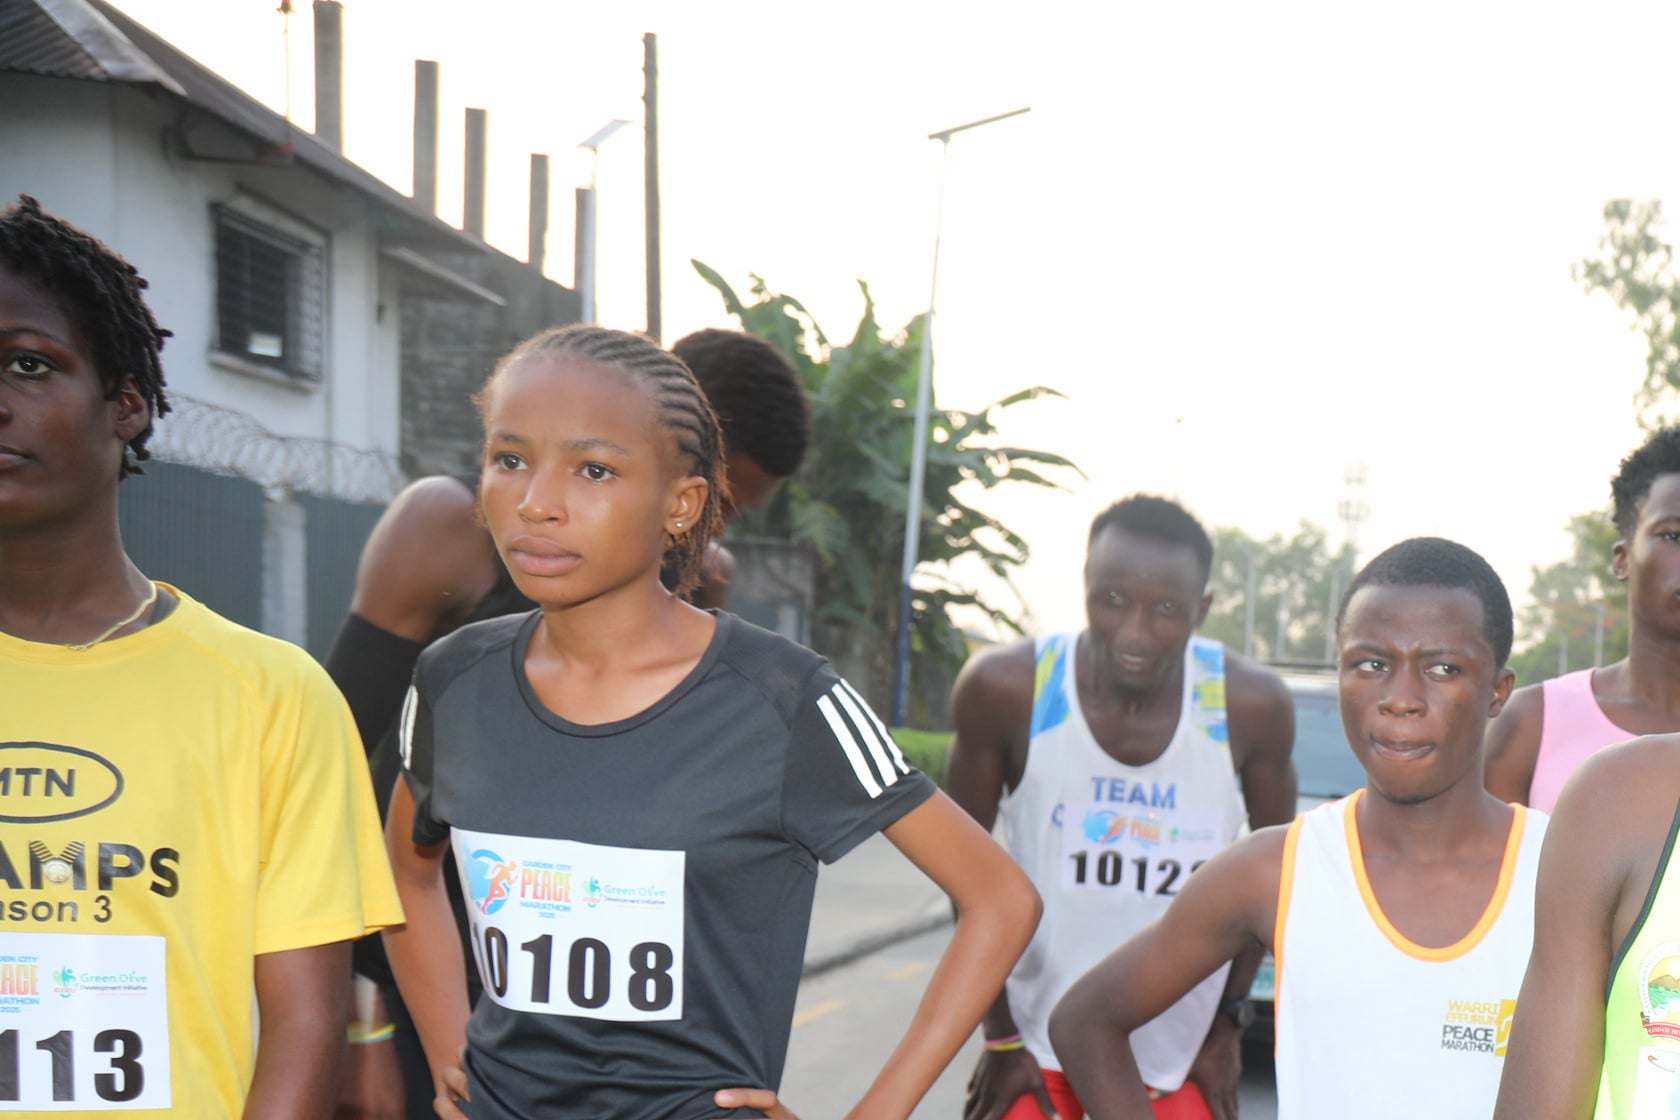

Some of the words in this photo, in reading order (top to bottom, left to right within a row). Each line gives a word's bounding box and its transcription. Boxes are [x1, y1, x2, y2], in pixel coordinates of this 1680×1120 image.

[1091, 775, 1177, 809] TEAM
[520, 868, 572, 903] PEACE
[604, 884, 636, 896] Green
[638, 884, 666, 897] Olive
[94, 895, 112, 922] 3
[80, 973, 117, 984] Green
[119, 971, 148, 984] Olive
[1443, 1025, 1494, 1042] PEACE
[1441, 1039, 1495, 1053] MARATHON
